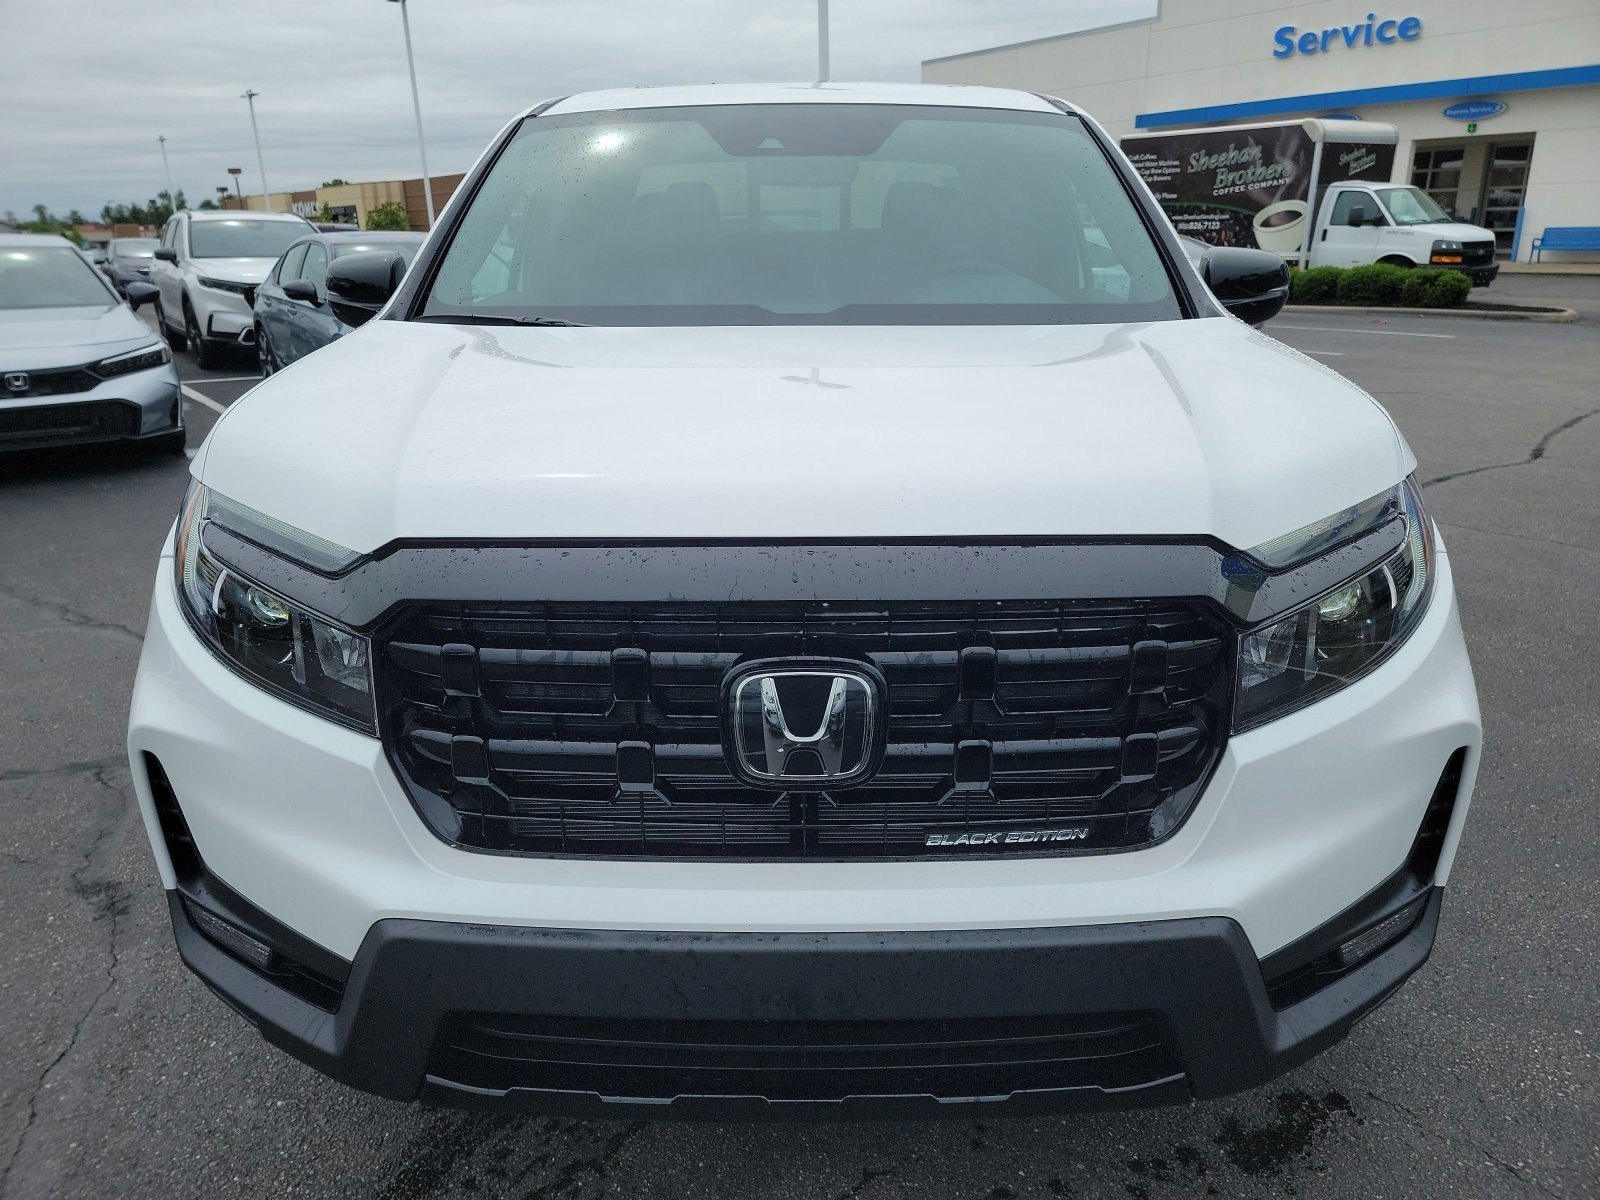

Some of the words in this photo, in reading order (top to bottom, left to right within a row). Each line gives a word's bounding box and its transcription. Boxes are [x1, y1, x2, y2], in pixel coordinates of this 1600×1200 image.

[1272, 12, 1421, 59] Service
[1187, 143, 1262, 174] Sheehan
[1212, 184, 1246, 196] COFFEE
[1247, 177, 1290, 190] COMPANY
[1213, 159, 1294, 189] Brothers
[925, 833, 1002, 846] BLACK
[1004, 829, 1089, 843] EDITION
